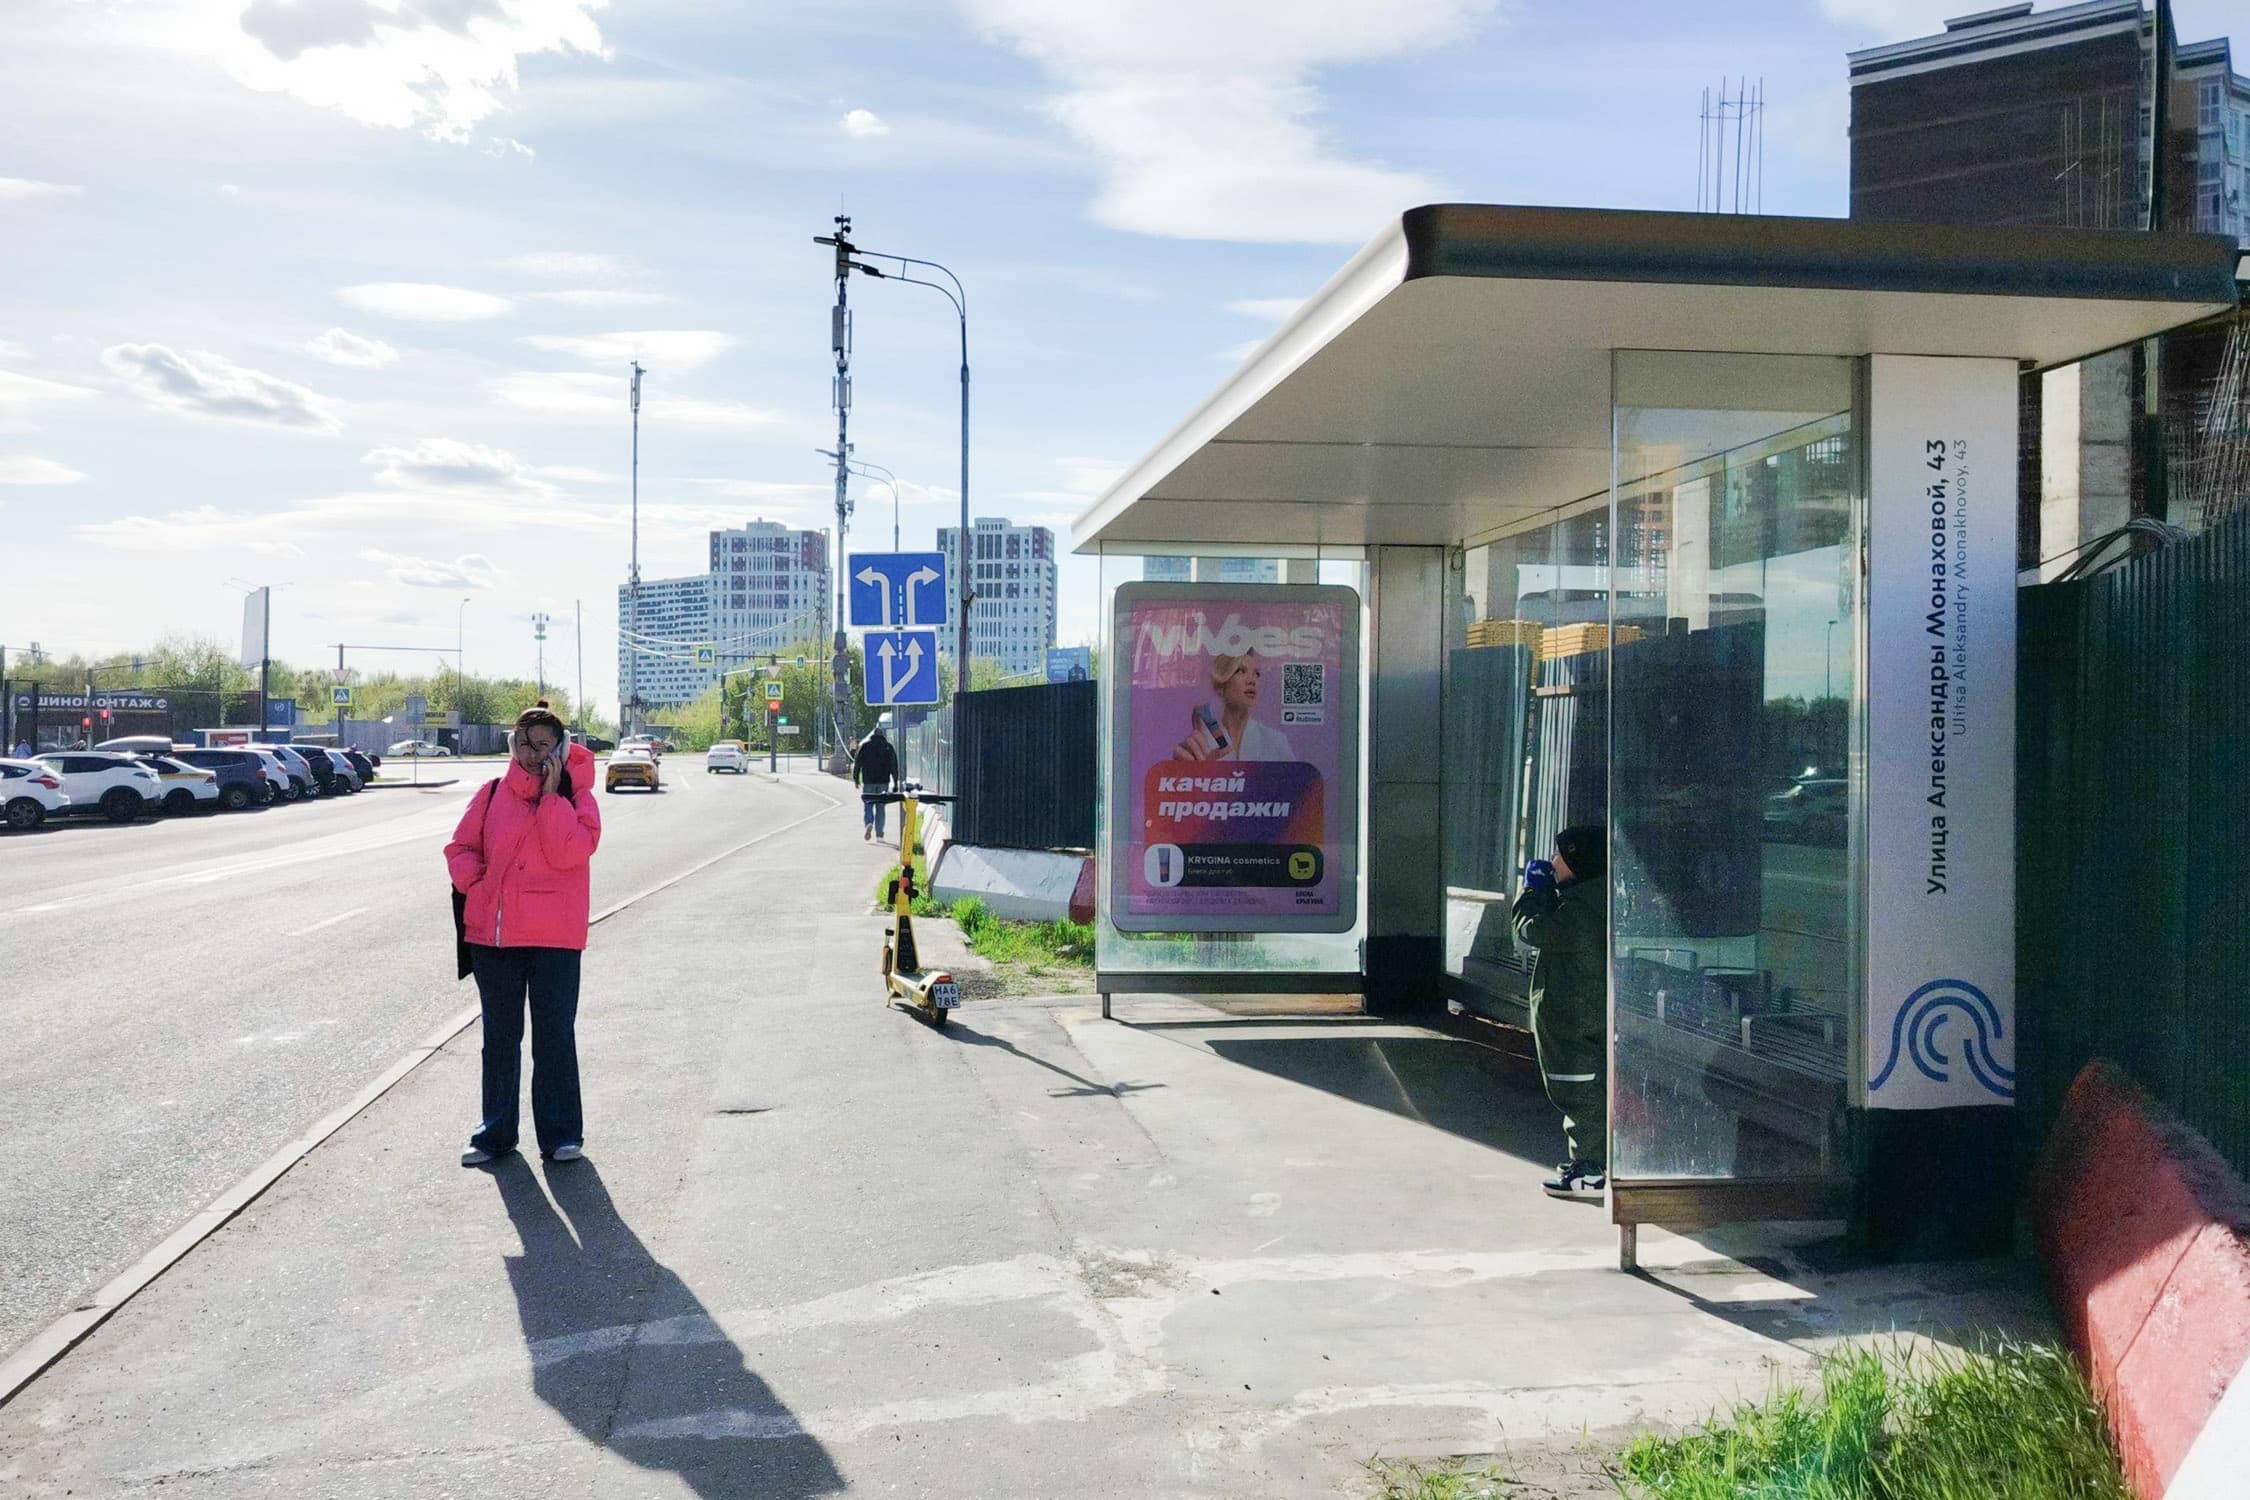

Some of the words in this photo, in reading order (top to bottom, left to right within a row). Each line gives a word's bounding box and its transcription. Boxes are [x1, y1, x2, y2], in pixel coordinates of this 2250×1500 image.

[1926, 439, 1946, 471] 43
[1953, 439, 1967, 460] 43
[1953, 465, 1969, 580] Monakhovoy,
[1926, 478, 1949, 638] Монаховой,
[1952, 584, 1969, 684] Aleksandry
[1926, 645, 1949, 808] Александры
[1952, 685, 1967, 736] Ulitsa
[1158, 770, 1246, 793] качай
[1158, 801, 1291, 823] продажи
[1188, 856, 1231, 865] KRYGINA
[1232, 856, 1281, 865] cosmetics
[1926, 815, 1949, 895] Улица
